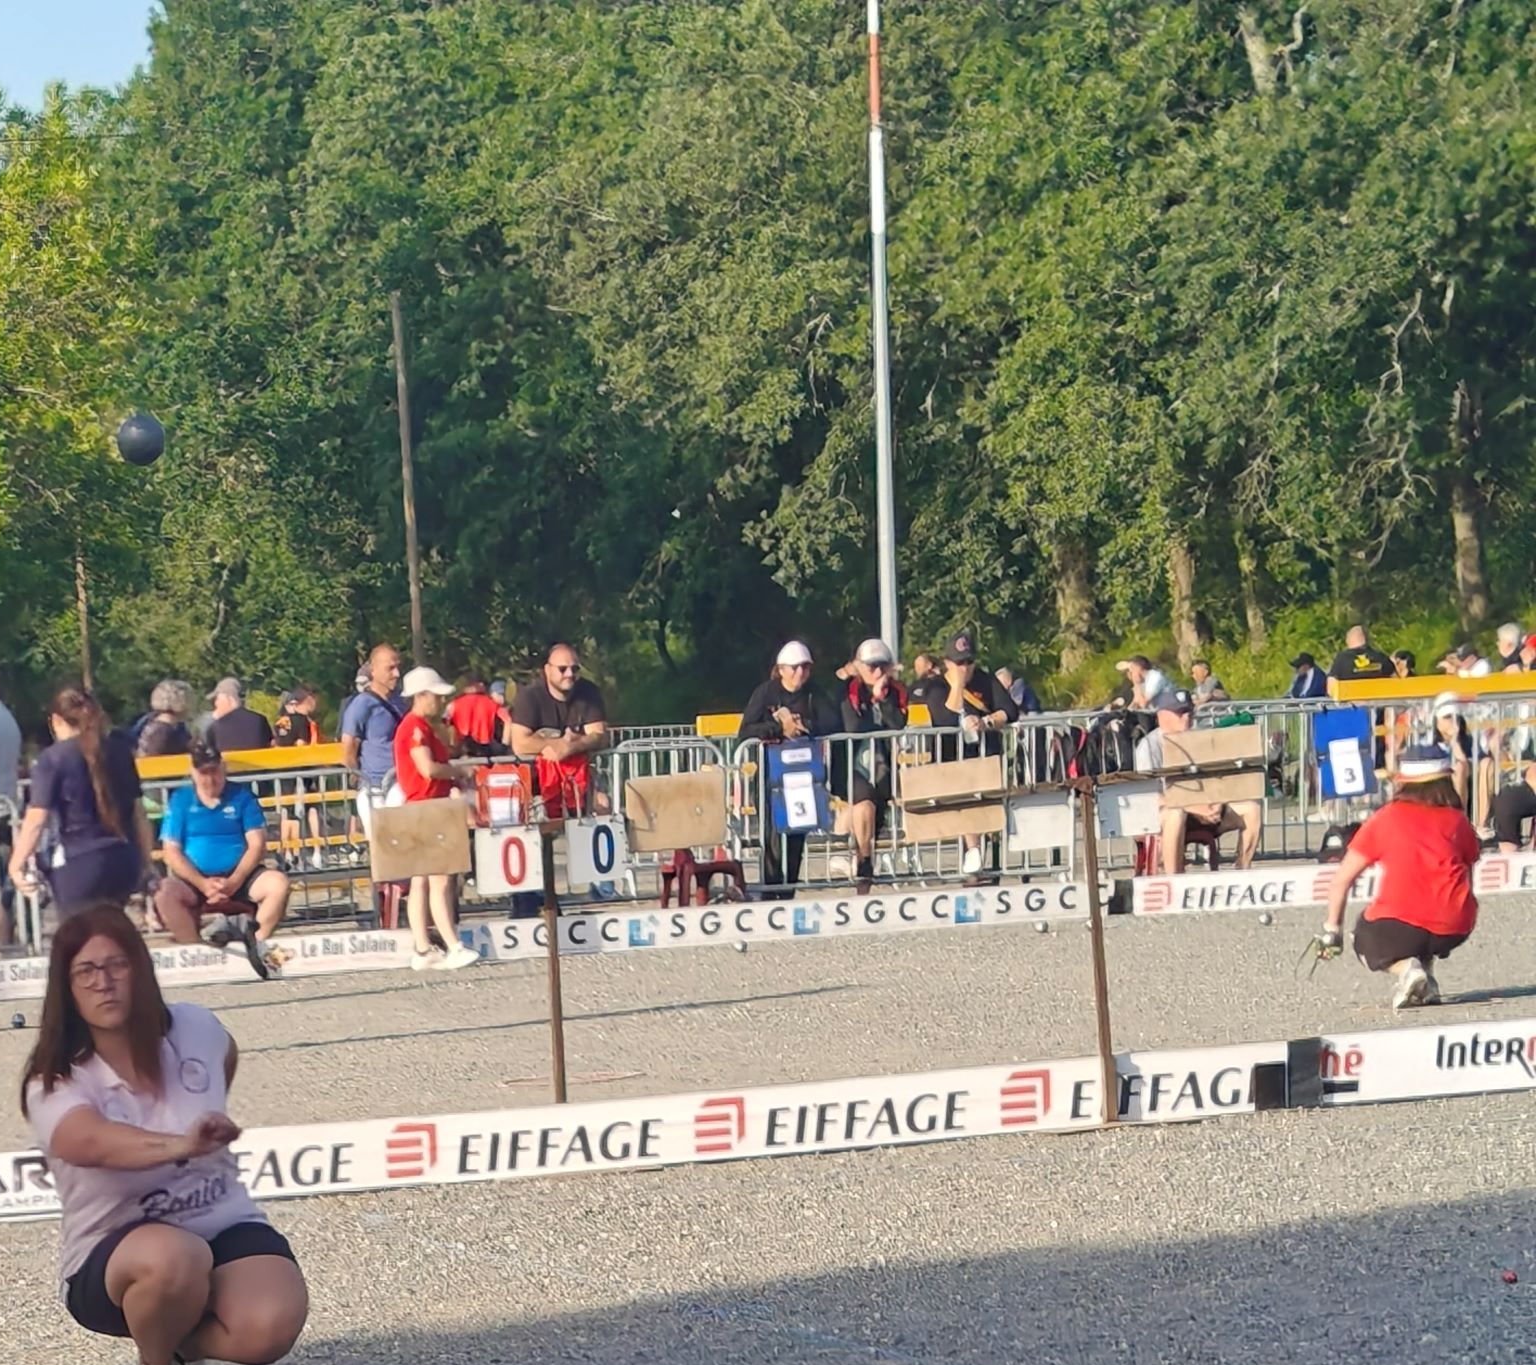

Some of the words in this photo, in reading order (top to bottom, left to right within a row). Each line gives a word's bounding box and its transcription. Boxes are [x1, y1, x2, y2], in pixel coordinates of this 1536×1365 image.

[1344, 768, 1356, 783] 3
[794, 801, 807, 817] 3
[502, 836, 526, 886] 0
[593, 824, 614, 874] 0
[996, 883, 1108, 914] SGC
[1182, 880, 1295, 910] EIFFAGE
[1070, 1065, 1257, 1118] EFFAG
[765, 1090, 970, 1147] EIFFAGE
[234, 1142, 354, 1190] FAGE
[457, 1118, 663, 1175] EIFFAGE
